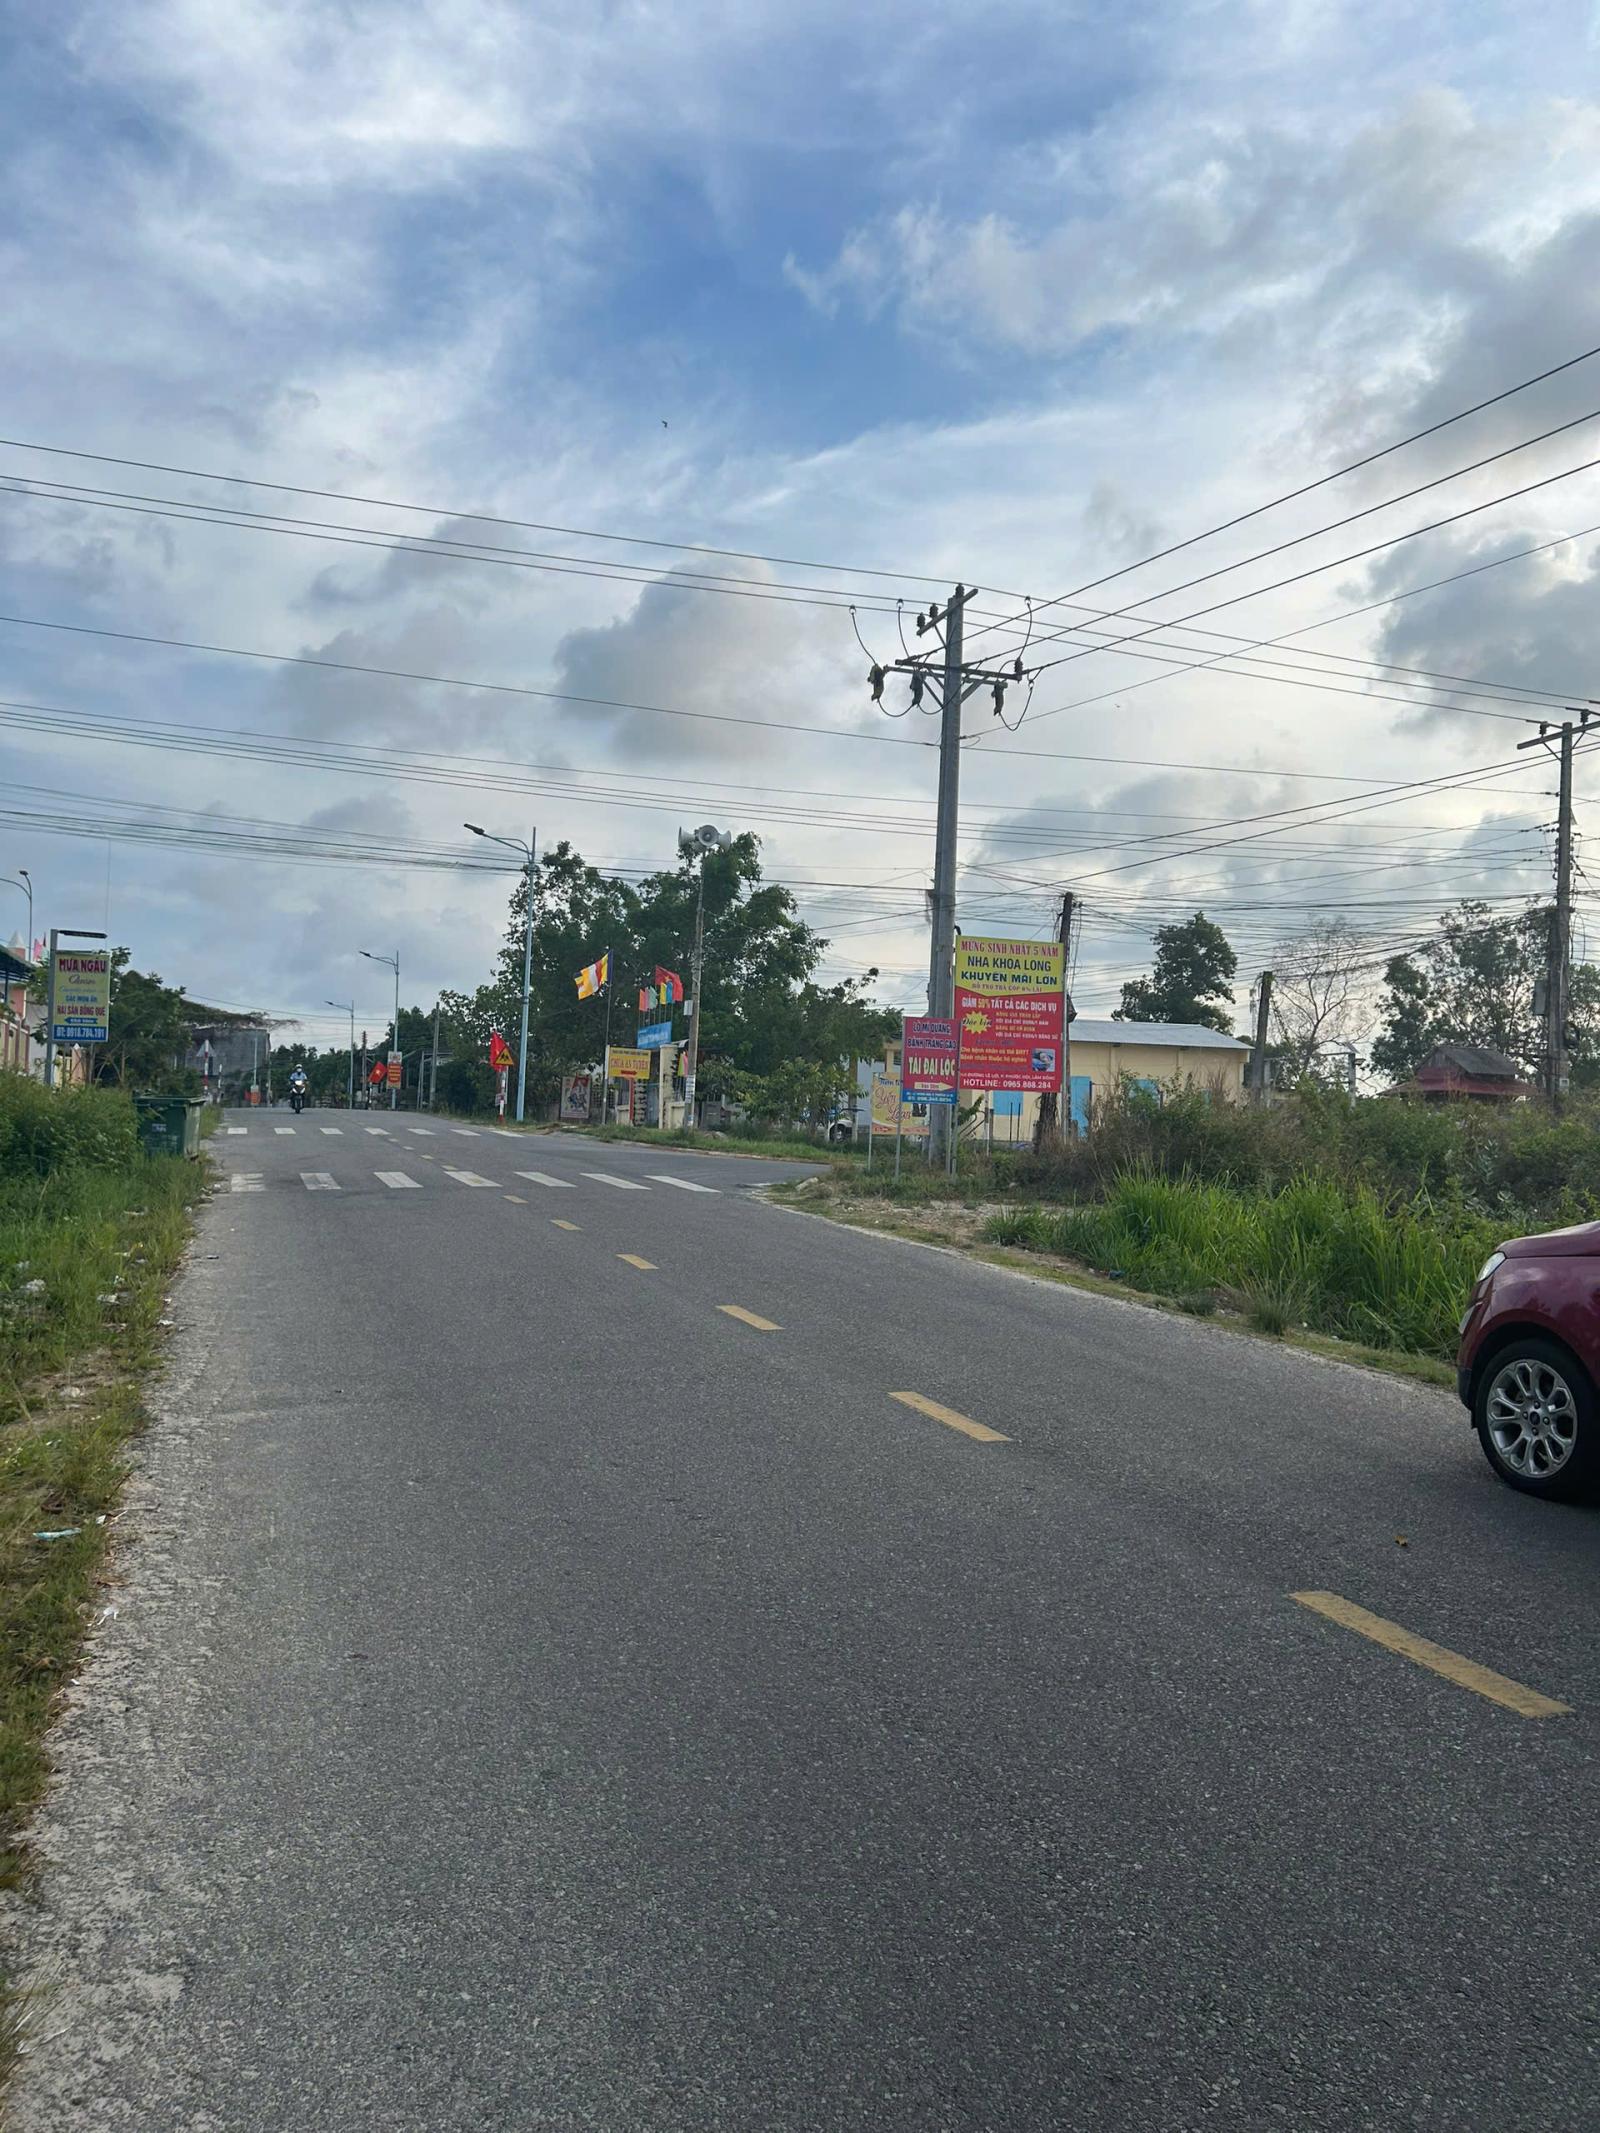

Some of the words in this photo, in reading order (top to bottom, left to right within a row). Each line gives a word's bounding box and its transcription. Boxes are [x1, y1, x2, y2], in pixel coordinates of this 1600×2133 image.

[987, 942, 1007, 954] SINH
[1033, 945, 1038, 956] 5
[968, 956, 989, 968] NHA
[993, 958, 1021, 970] KHOA
[1024, 960, 1051, 972] LONG
